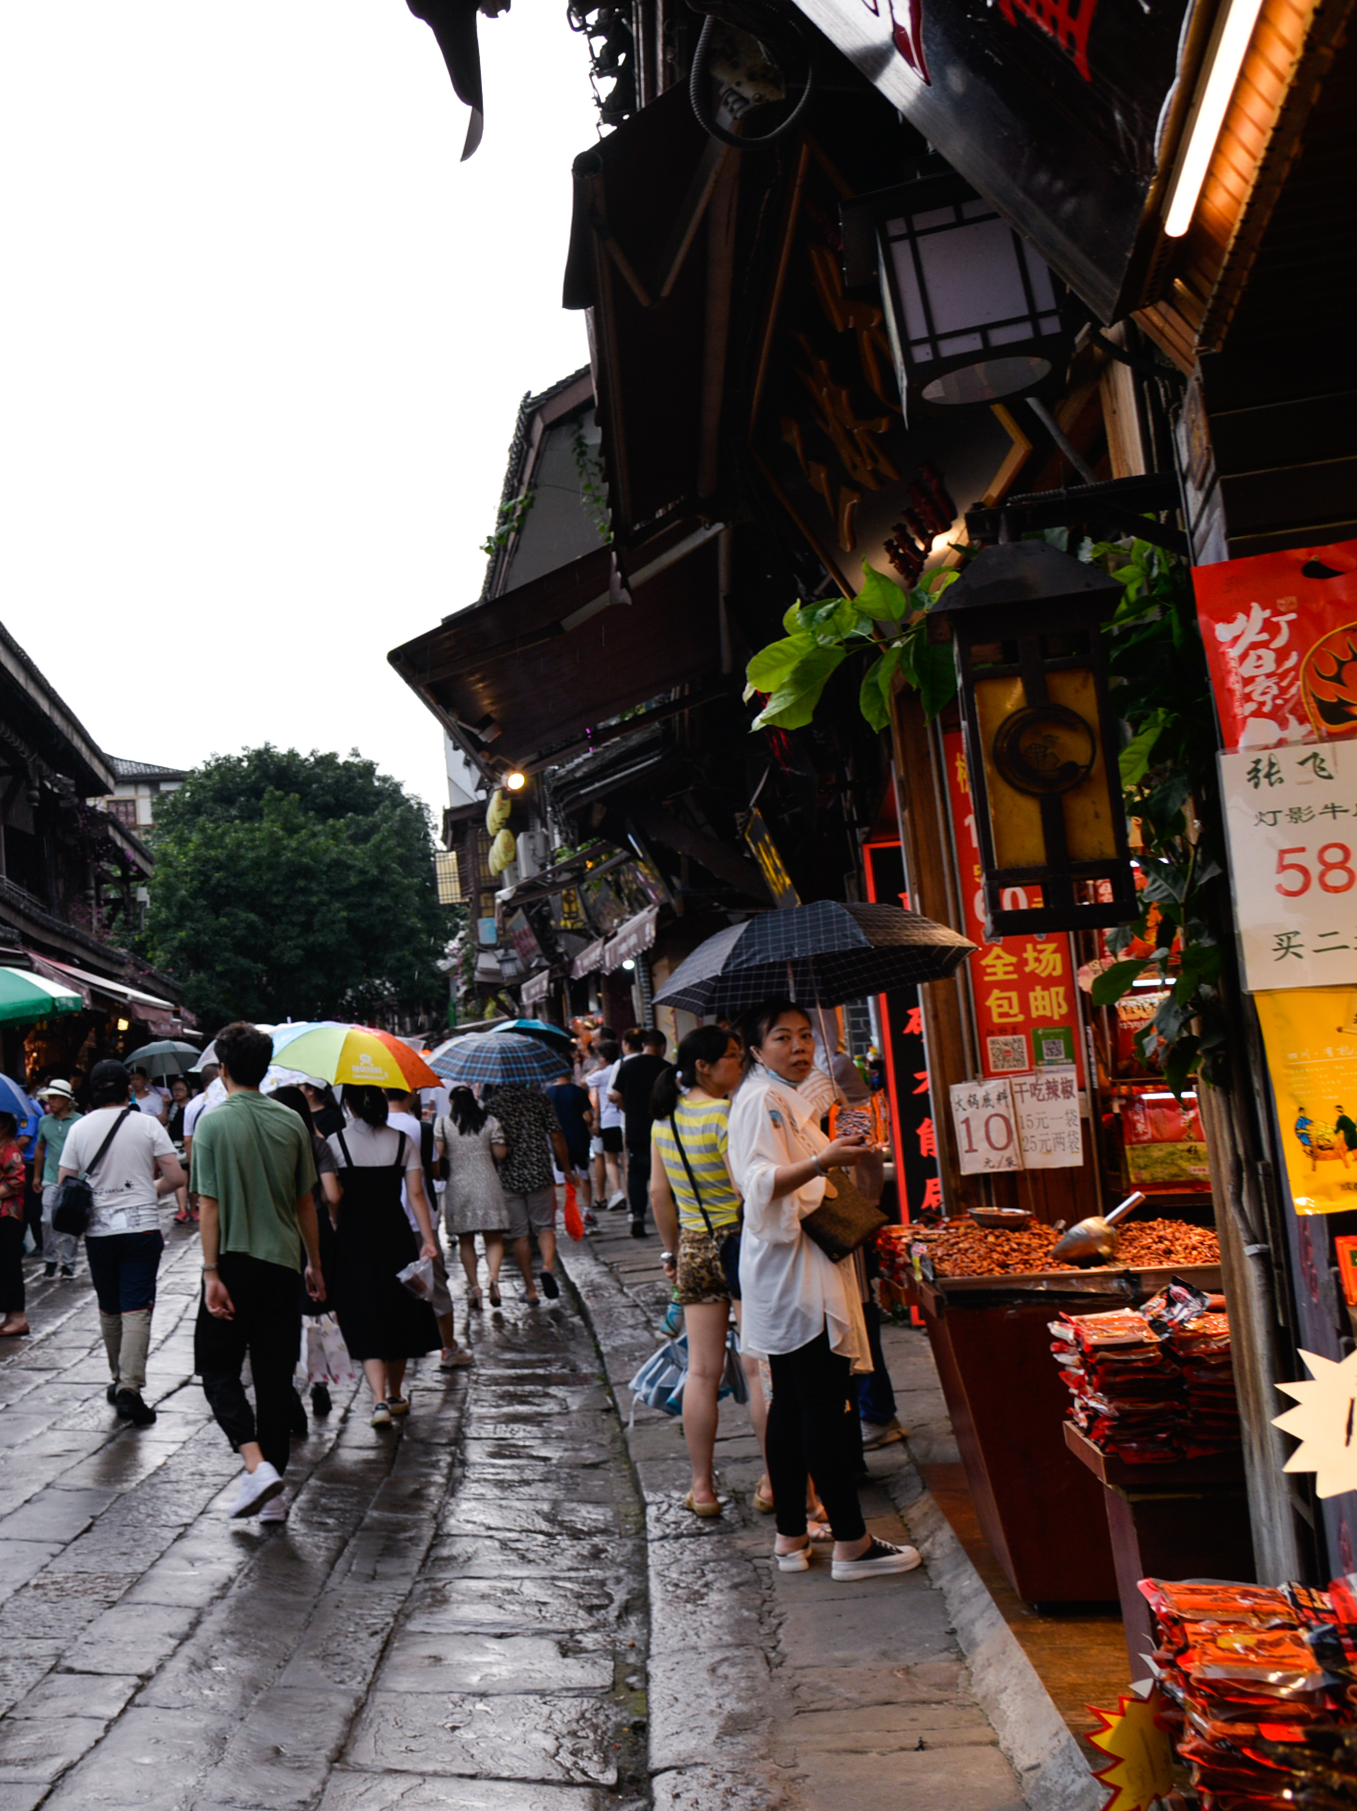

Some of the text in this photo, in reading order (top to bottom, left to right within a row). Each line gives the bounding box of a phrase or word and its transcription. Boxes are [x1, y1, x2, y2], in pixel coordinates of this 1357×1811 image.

[1246, 752, 1334, 790] 张飞
[1254, 802, 1357, 827] 灯影牛
[1275, 842, 1356, 897] 58
[980, 943, 1063, 981] 全场
[1272, 927, 1357, 962] 买二
[985, 986, 1068, 1023] 包邮
[1014, 1077, 1076, 1103] 干吃辣椒
[960, 1113, 1013, 1153] 10
[1020, 1109, 1079, 1130] 15元一袋
